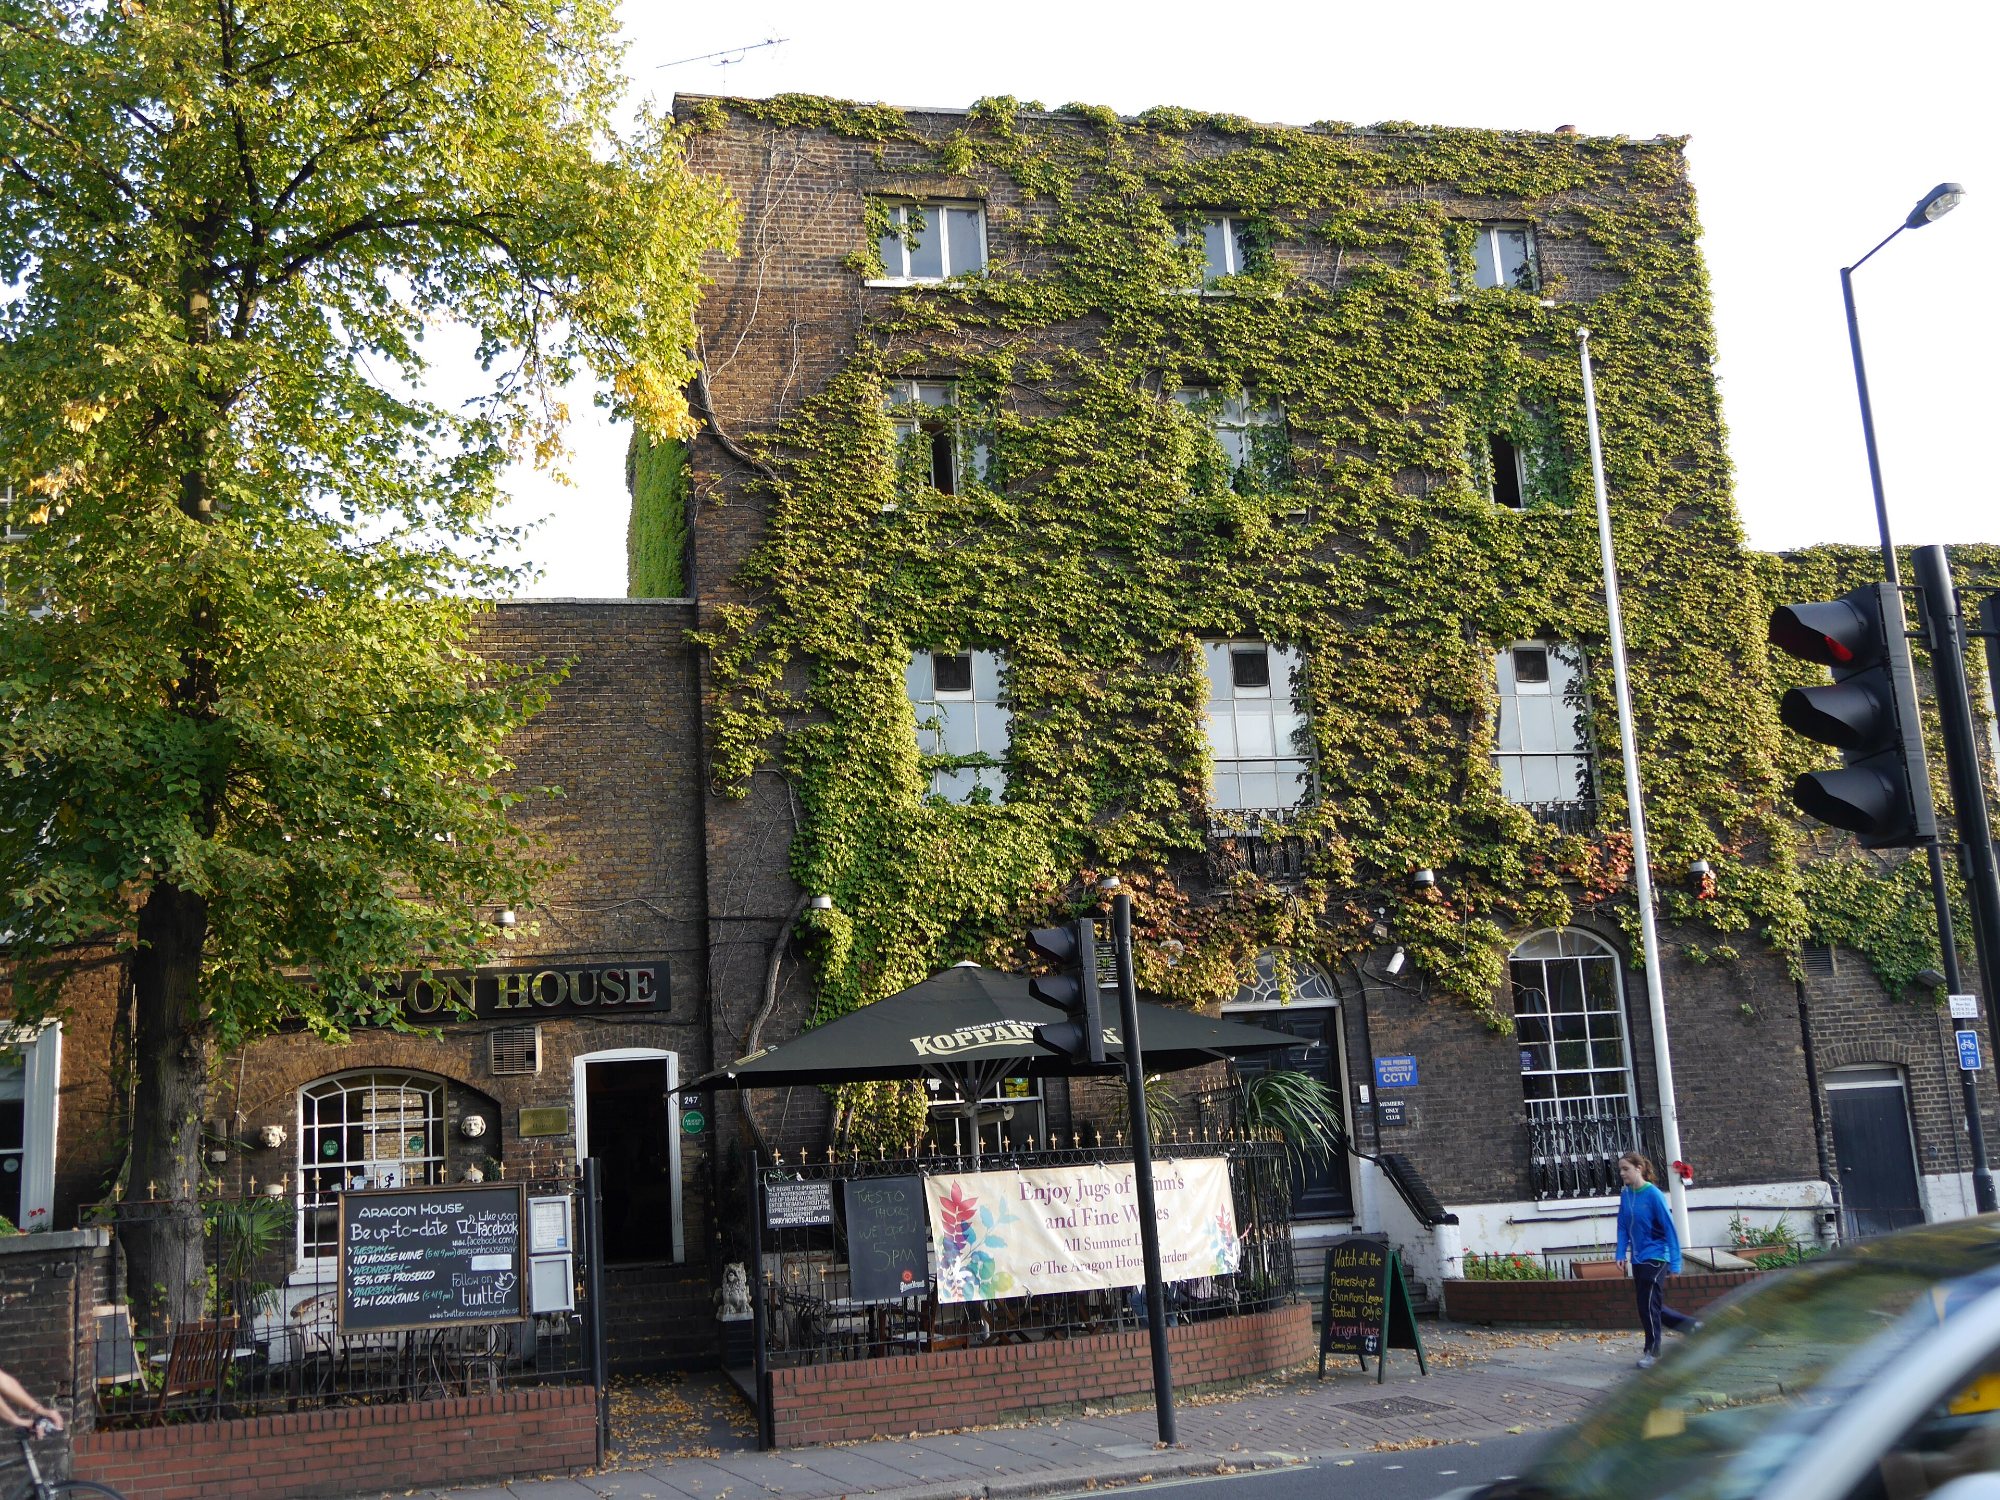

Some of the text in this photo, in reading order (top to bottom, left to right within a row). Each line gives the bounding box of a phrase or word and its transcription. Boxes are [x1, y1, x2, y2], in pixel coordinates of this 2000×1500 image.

[494, 968, 657, 1009] HOUSE
[955, 1019, 1016, 1033] PREMIUM
[910, 1024, 1124, 1056] KOPPARG
[1383, 1073, 1411, 1082] CCTV
[684, 1096, 698, 1104] 247
[1019, 1181, 1072, 1205] Enjoy
[1075, 1178, 1111, 1203] Jugs
[1115, 1174, 1131, 1194] of
[359, 1203, 464, 1219] ARAGON HOUSE
[479, 1210, 497, 1221] Like
[1046, 1203, 1169, 1229] and Fine Wes
[351, 1217, 448, 1242] Be up-to-date
[478, 1220, 518, 1237] Facebook
[1063, 1237, 1081, 1252] All
[1084, 1236, 1131, 1251] Summer
[368, 1252, 398, 1263] HOUSE
[399, 1249, 424, 1260] WINE
[1030, 1250, 1188, 1276] @ The Aragon Hous arden
[1334, 1249, 1381, 1268] Watch all the
[354, 1270, 436, 1286] 25% OFF PROSECCO
[452, 1273, 493, 1288] Follow on
[1368, 1278, 1376, 1288] &
[375, 1292, 420, 1306] COCKTAILS
[462, 1285, 511, 1307] twitter
[1331, 1304, 1357, 1318] Football
[1330, 1322, 1380, 1340] Aragon House
